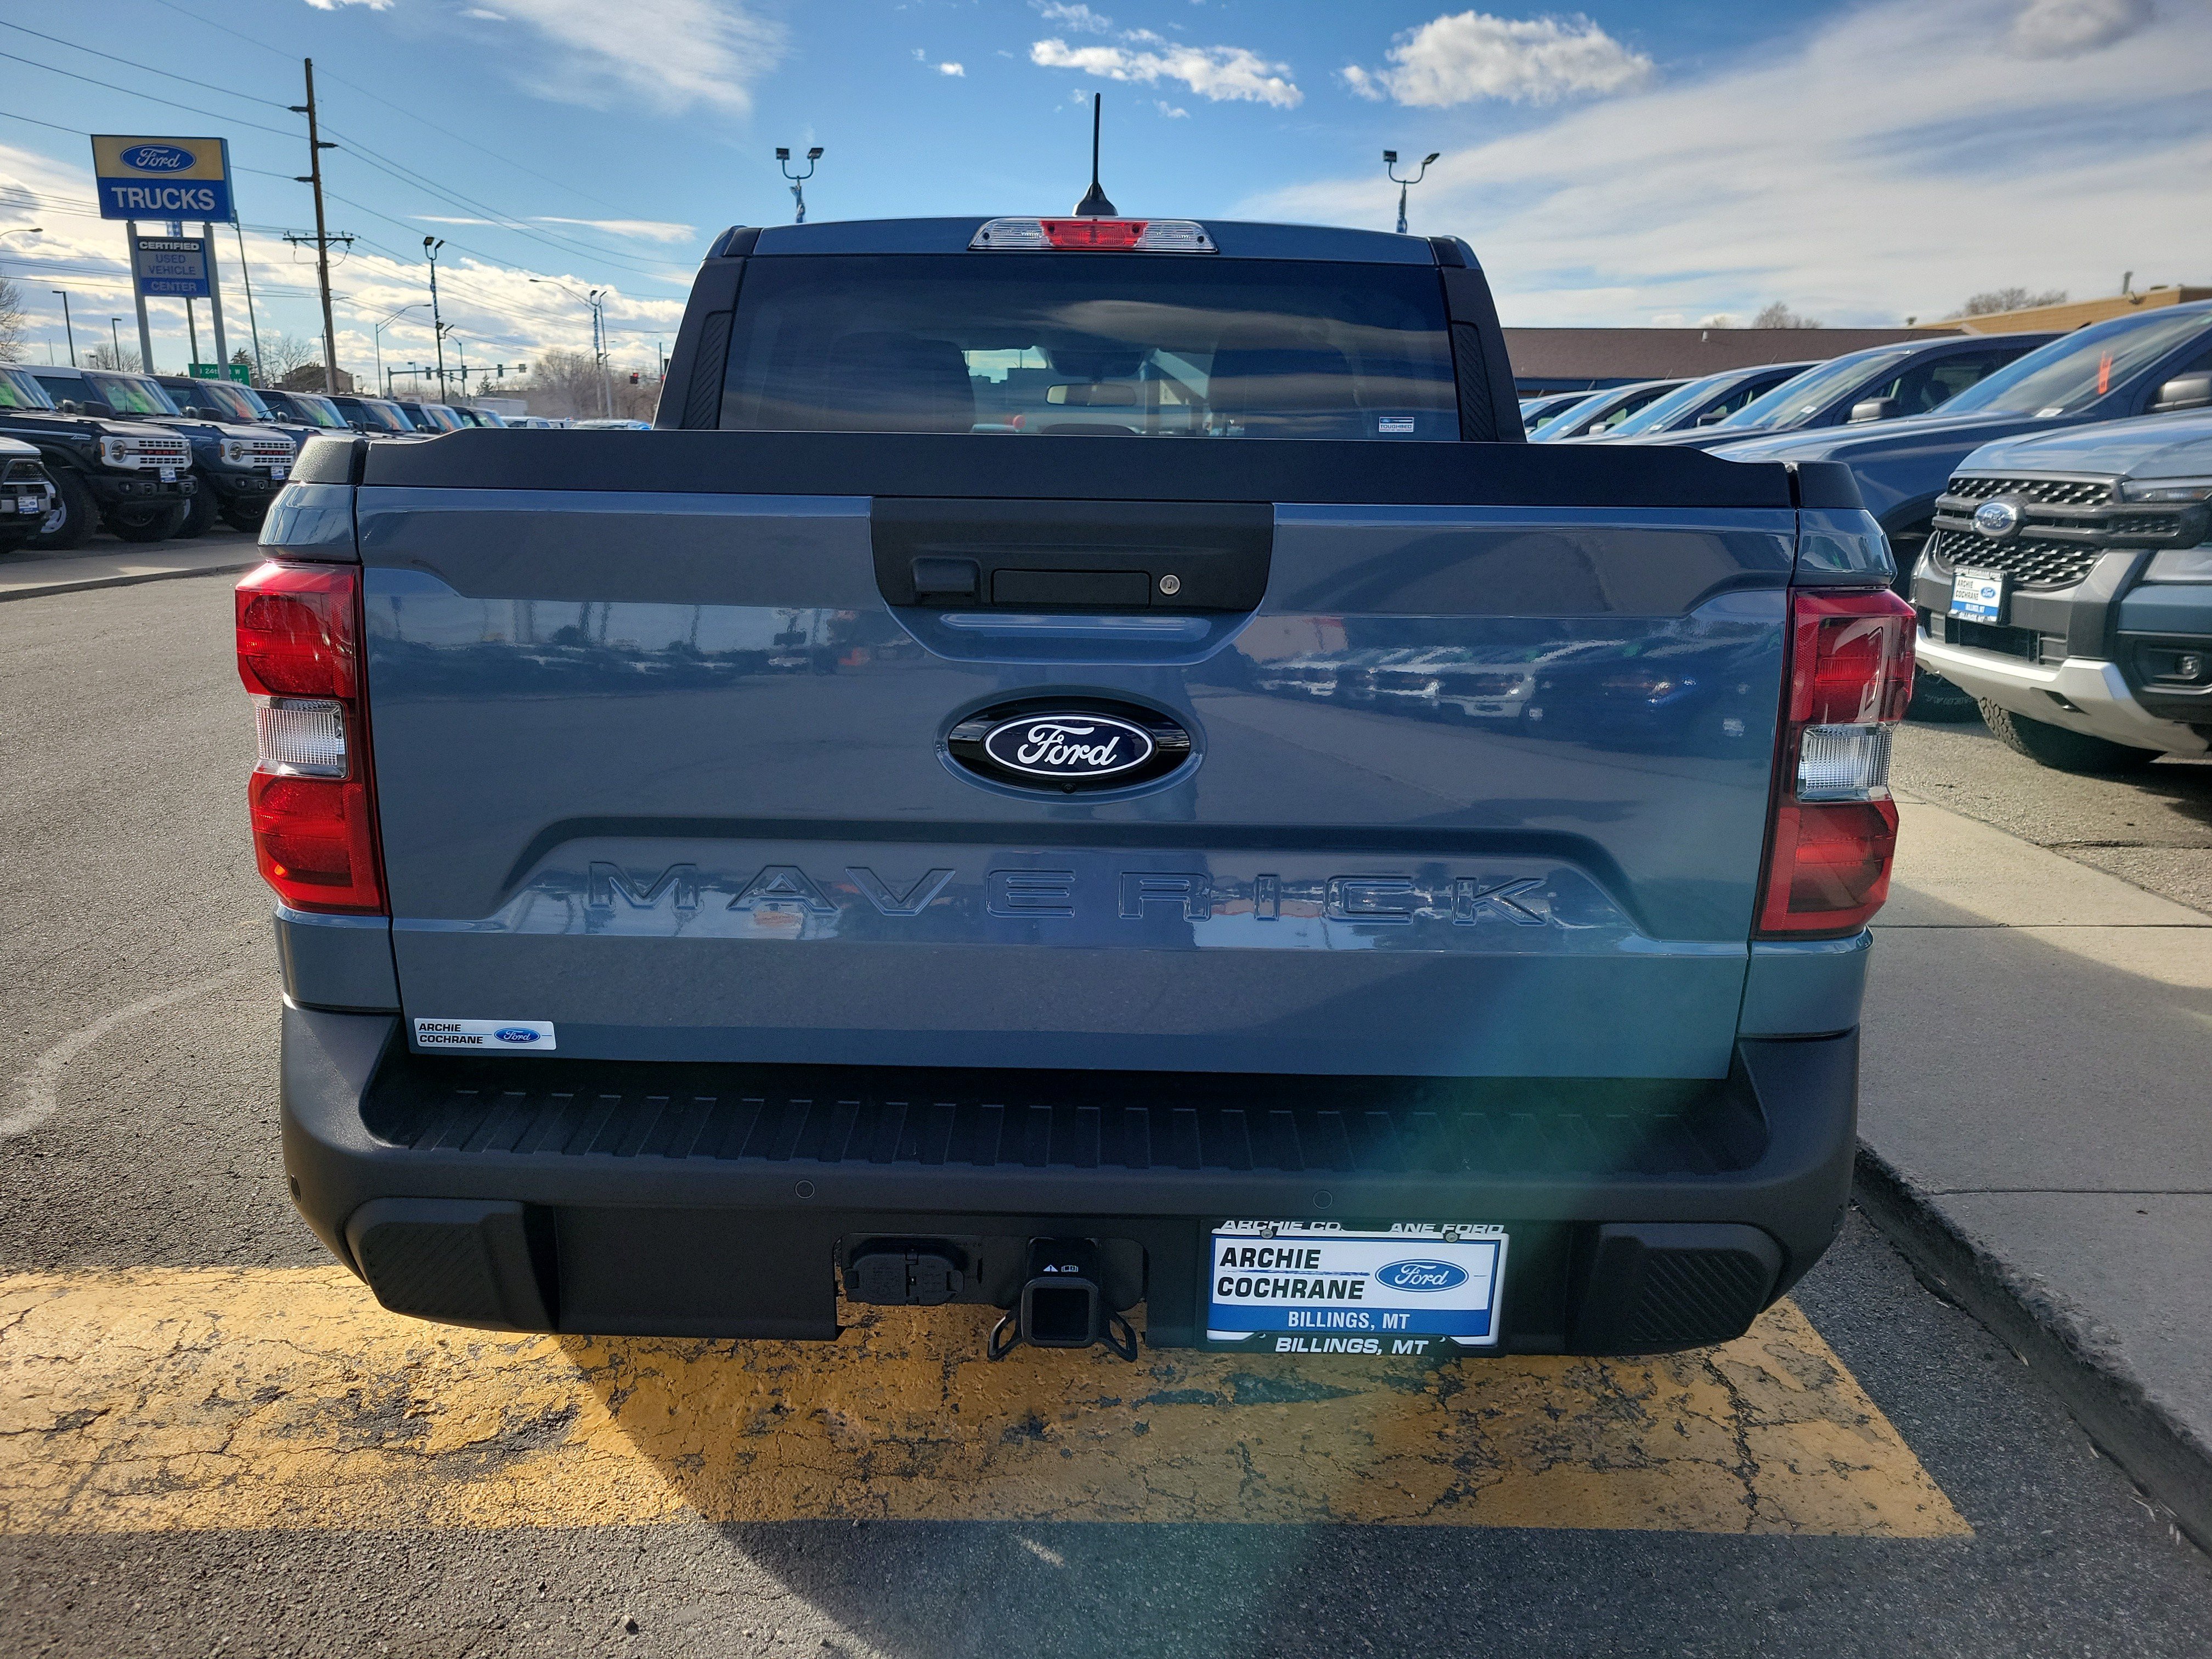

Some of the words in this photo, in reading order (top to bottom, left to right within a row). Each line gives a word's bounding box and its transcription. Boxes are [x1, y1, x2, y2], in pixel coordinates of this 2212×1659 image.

[136, 148, 180, 168] Ford
[111, 187, 216, 210] TRUCKS
[139, 241, 200, 251] CERTIFIED
[156, 254, 186, 263] USED
[149, 266, 195, 275] VEHICLE
[151, 281, 196, 292] CENTER
[1957, 579, 1973, 589] ARCHIE
[1955, 590, 1979, 601] COCHRANE
[1017, 724, 1120, 765] Ford
[589, 861, 1548, 926] MAVERICK
[419, 1023, 461, 1032] ARCHIE
[420, 1035, 483, 1044] COCHRANE
[503, 1030, 531, 1041] Ford
[1441, 1224, 1504, 1234] FORD
[1220, 1247, 1321, 1269] ARCHIE
[1393, 1263, 1451, 1286] Ford
[1217, 1277, 1365, 1300] COCHRANE
[1288, 1311, 1375, 1331] BILLINGS,
[1382, 1313, 1410, 1329] MT
[1275, 1337, 1382, 1356] BILLINGS,
[1392, 1339, 1429, 1355] MT
